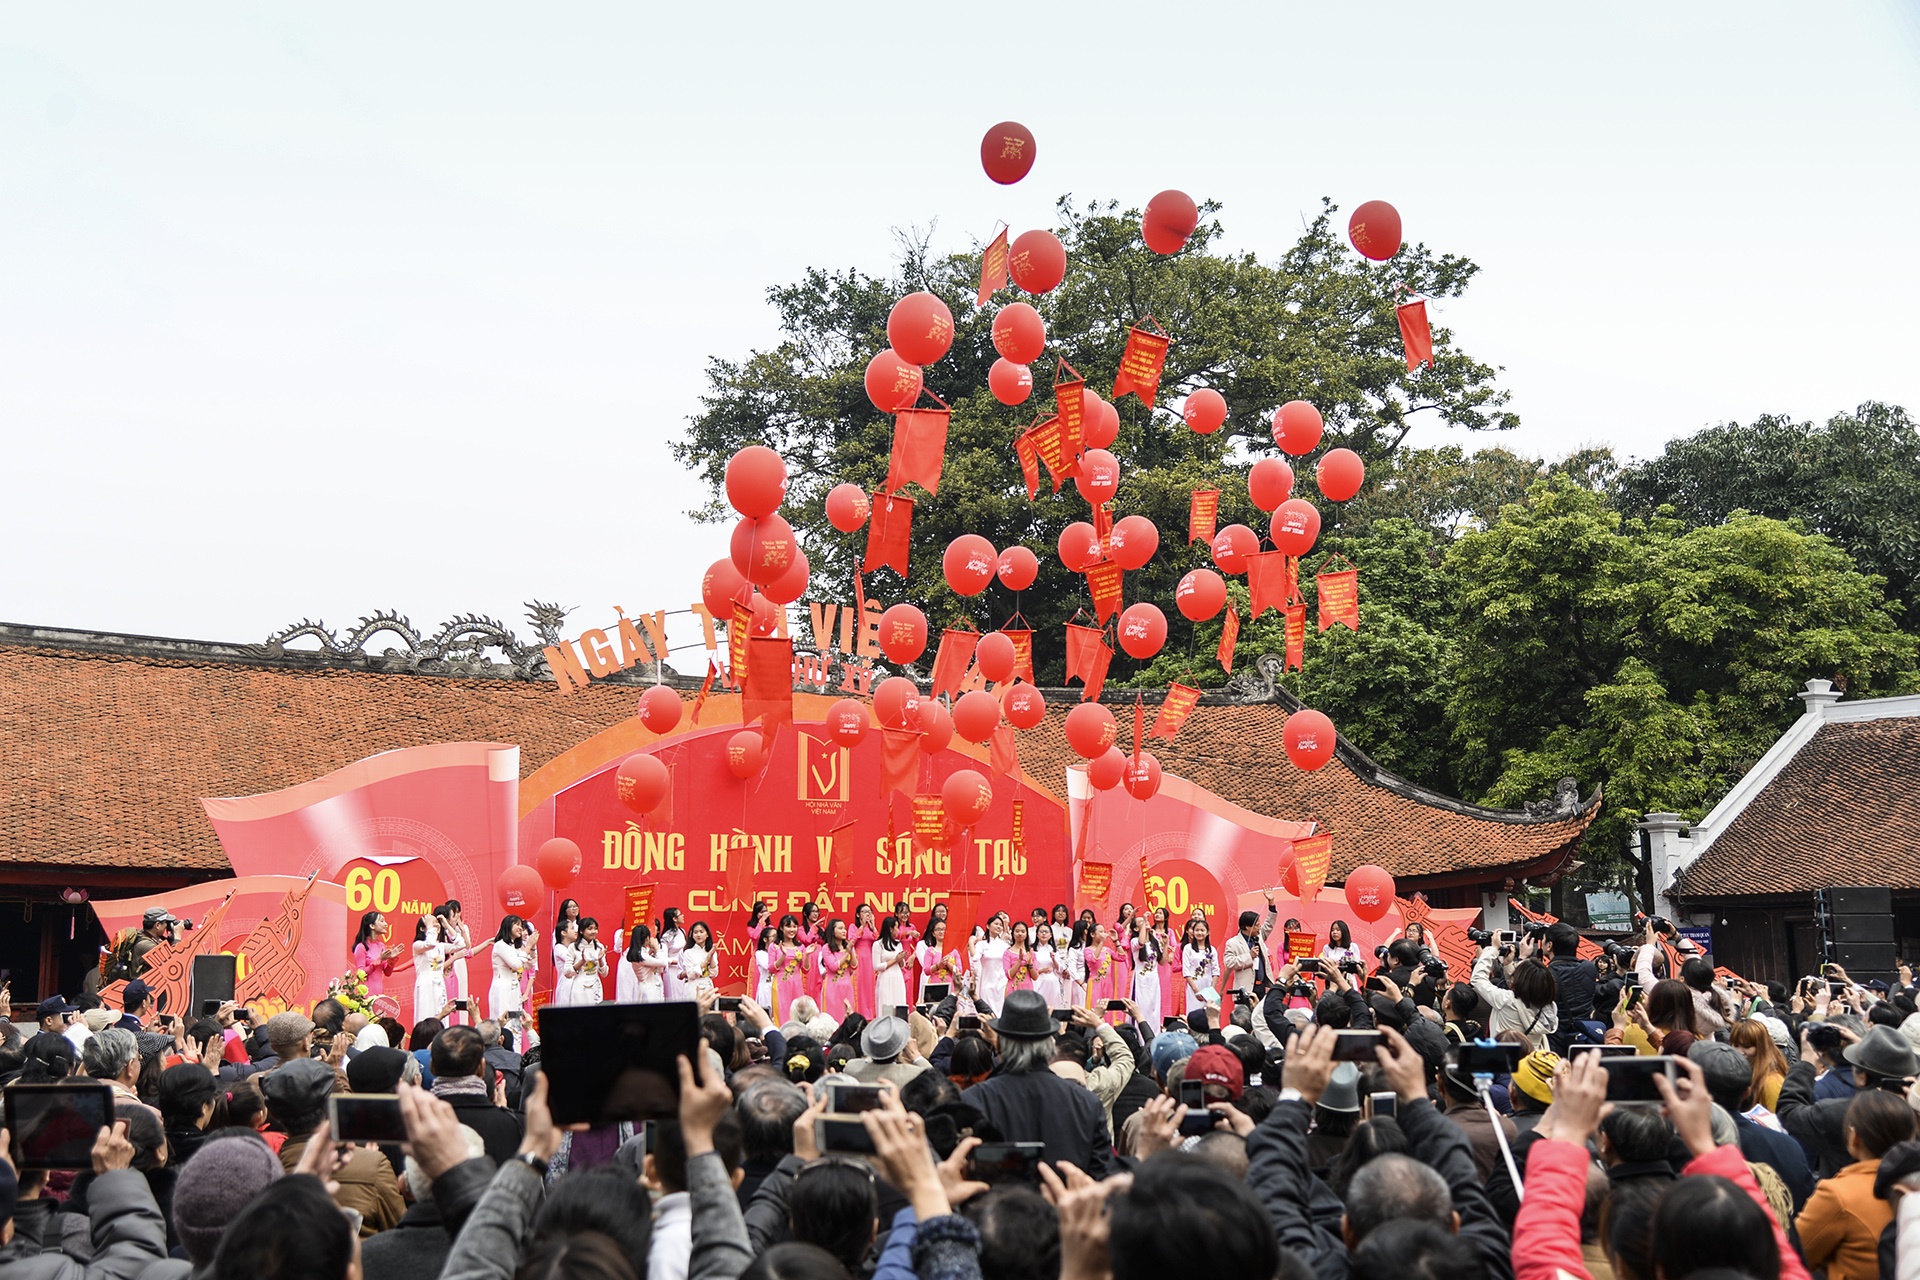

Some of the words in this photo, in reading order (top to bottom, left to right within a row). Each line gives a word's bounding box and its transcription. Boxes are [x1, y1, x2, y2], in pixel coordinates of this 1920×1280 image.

[542, 605, 670, 695] NGÀY
[809, 597, 881, 668] VIỆ
[794, 652, 833, 686] HỨ
[837, 662, 877, 697] XV
[829, 801, 842, 809] VĂN
[601, 820, 685, 876] ĐỒNG
[876, 831, 951, 880] SÁNG
[974, 838, 1028, 881] TẠO
[344, 866, 402, 913] 60
[401, 899, 433, 915] NĂM
[688, 885, 778, 912] CÙNG
[786, 882, 854, 913] ĐẤT
[1144, 875, 1189, 915] 60
[715, 930, 753, 956] ẰM
